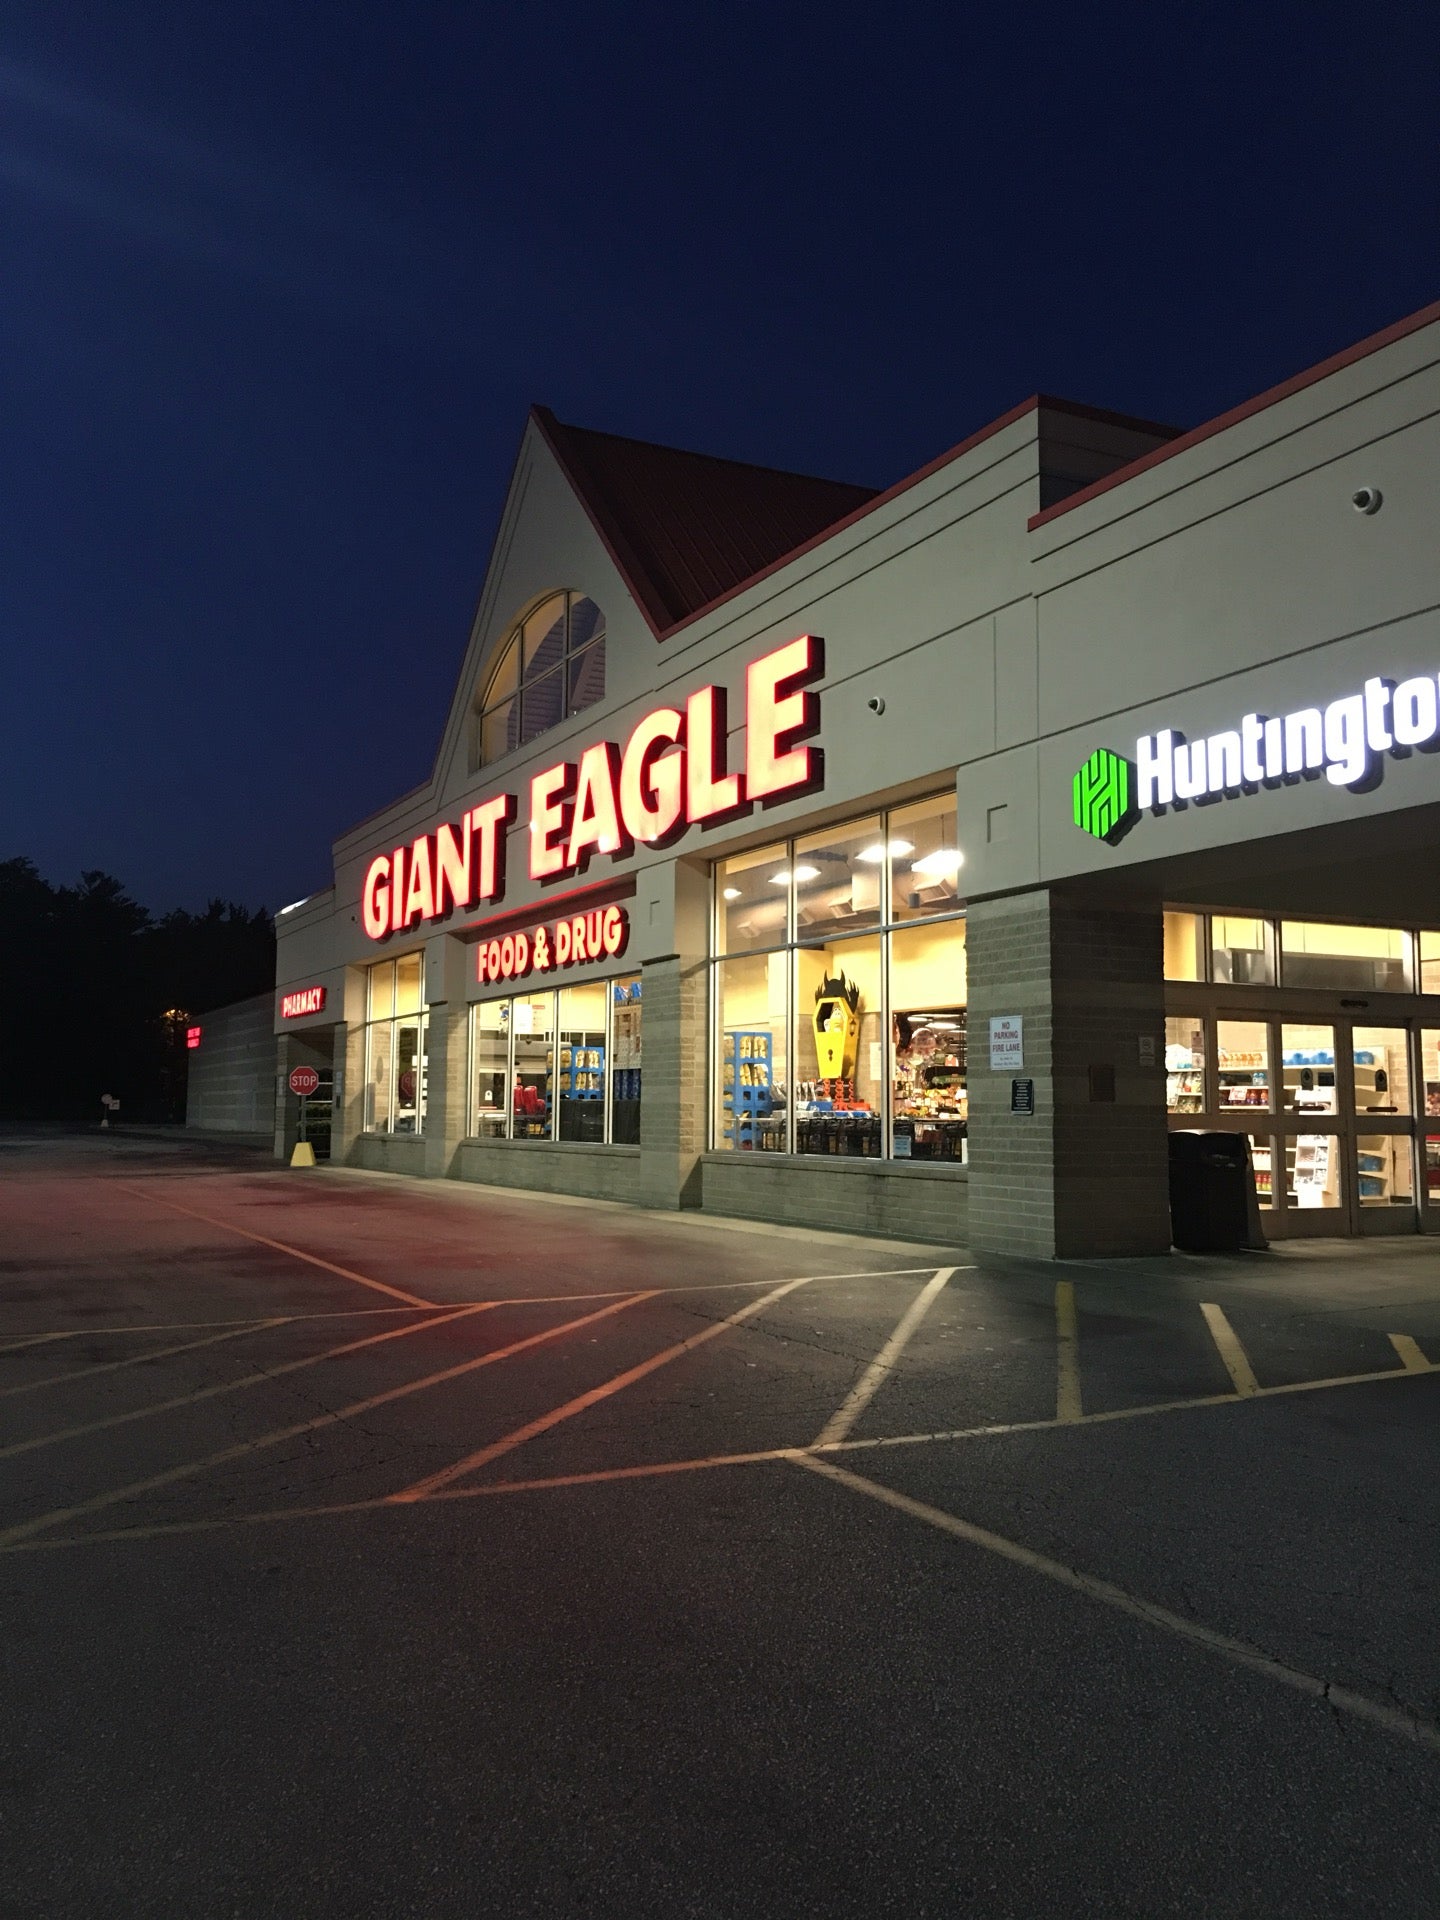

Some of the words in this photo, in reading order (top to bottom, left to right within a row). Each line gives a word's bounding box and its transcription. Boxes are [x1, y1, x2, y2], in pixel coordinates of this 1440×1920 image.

[1136, 671, 1440, 810] Huntingto
[362, 794, 510, 941] GIANT
[529, 635, 813, 880] EAGLE
[477, 932, 529, 983] FOOD
[532, 925, 551, 970] &
[555, 905, 624, 965] DRUG
[282, 987, 322, 1018] PHARMACY
[992, 1044, 1005, 1053] FIRE
[1005, 1042, 1021, 1052] LANE
[993, 1031, 1018, 1039] PARKING
[291, 1075, 317, 1087] STOP
